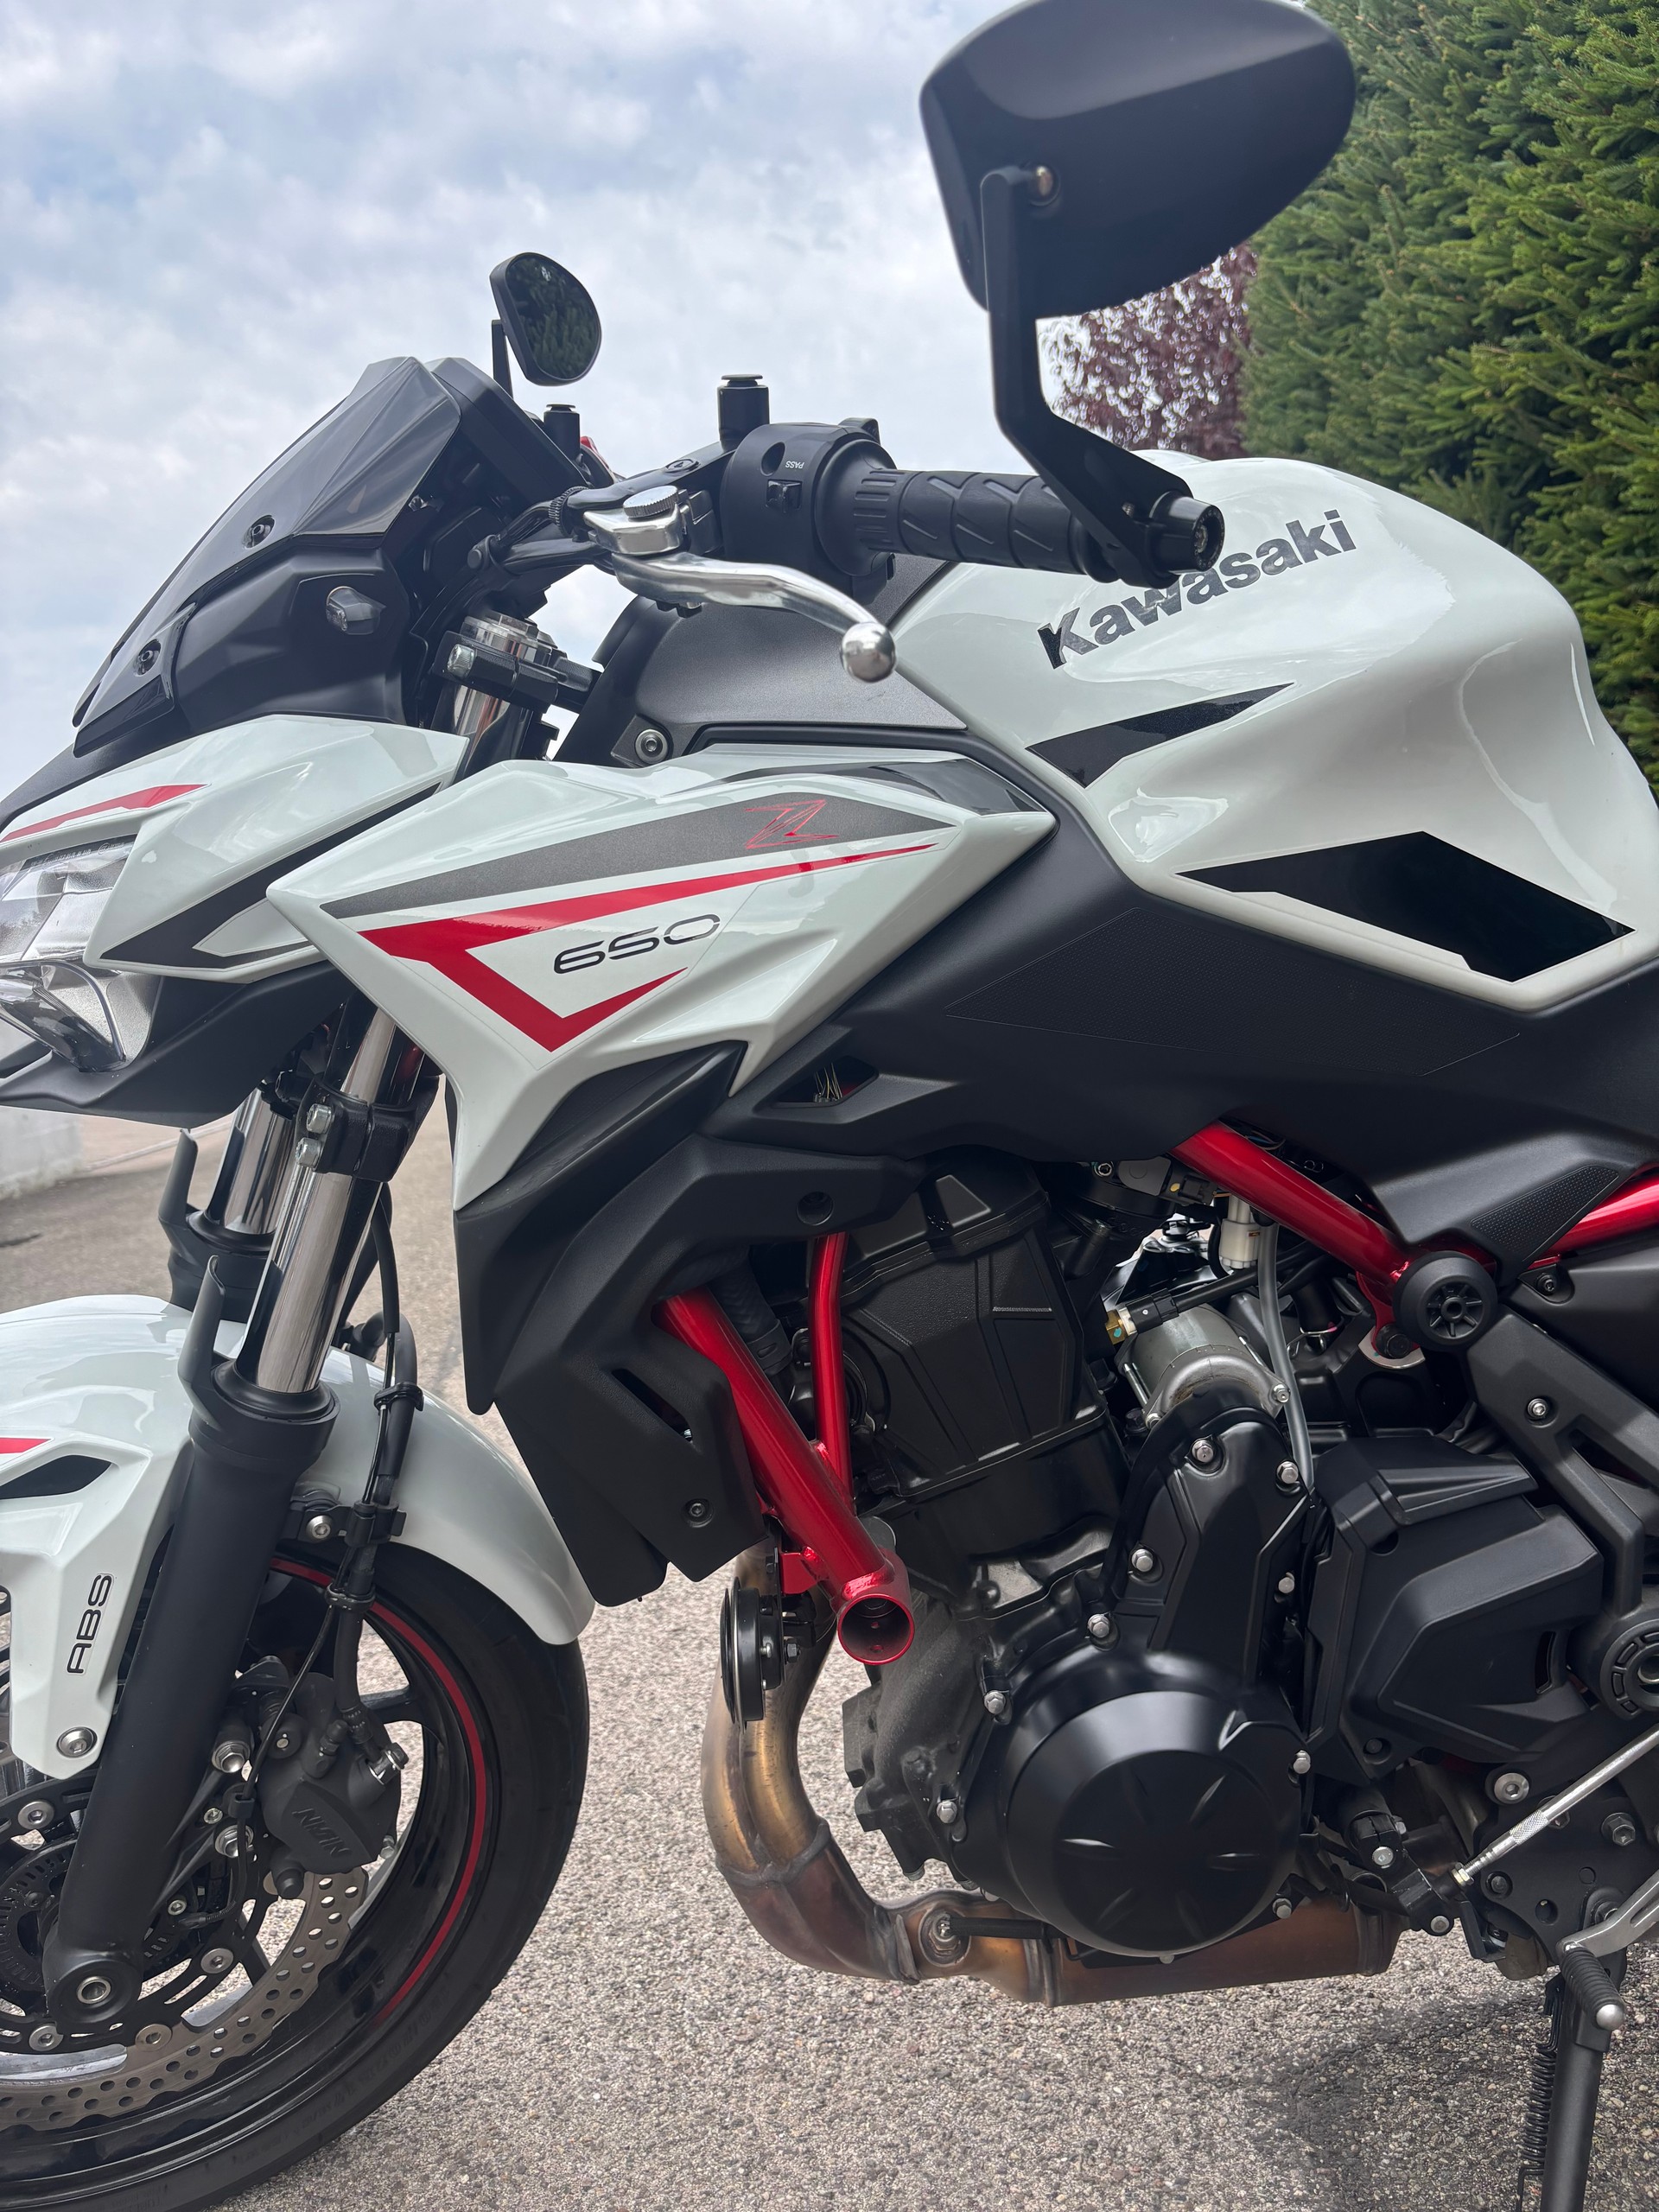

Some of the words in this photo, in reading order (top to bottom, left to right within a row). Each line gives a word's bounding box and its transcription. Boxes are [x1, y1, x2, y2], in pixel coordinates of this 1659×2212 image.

[785, 461, 804, 469] PASS
[1037, 509, 1357, 670] Kawasaki
[745, 799, 838, 849] Z
[554, 913, 721, 974] 650
[67, 1574, 112, 1674] ABS
